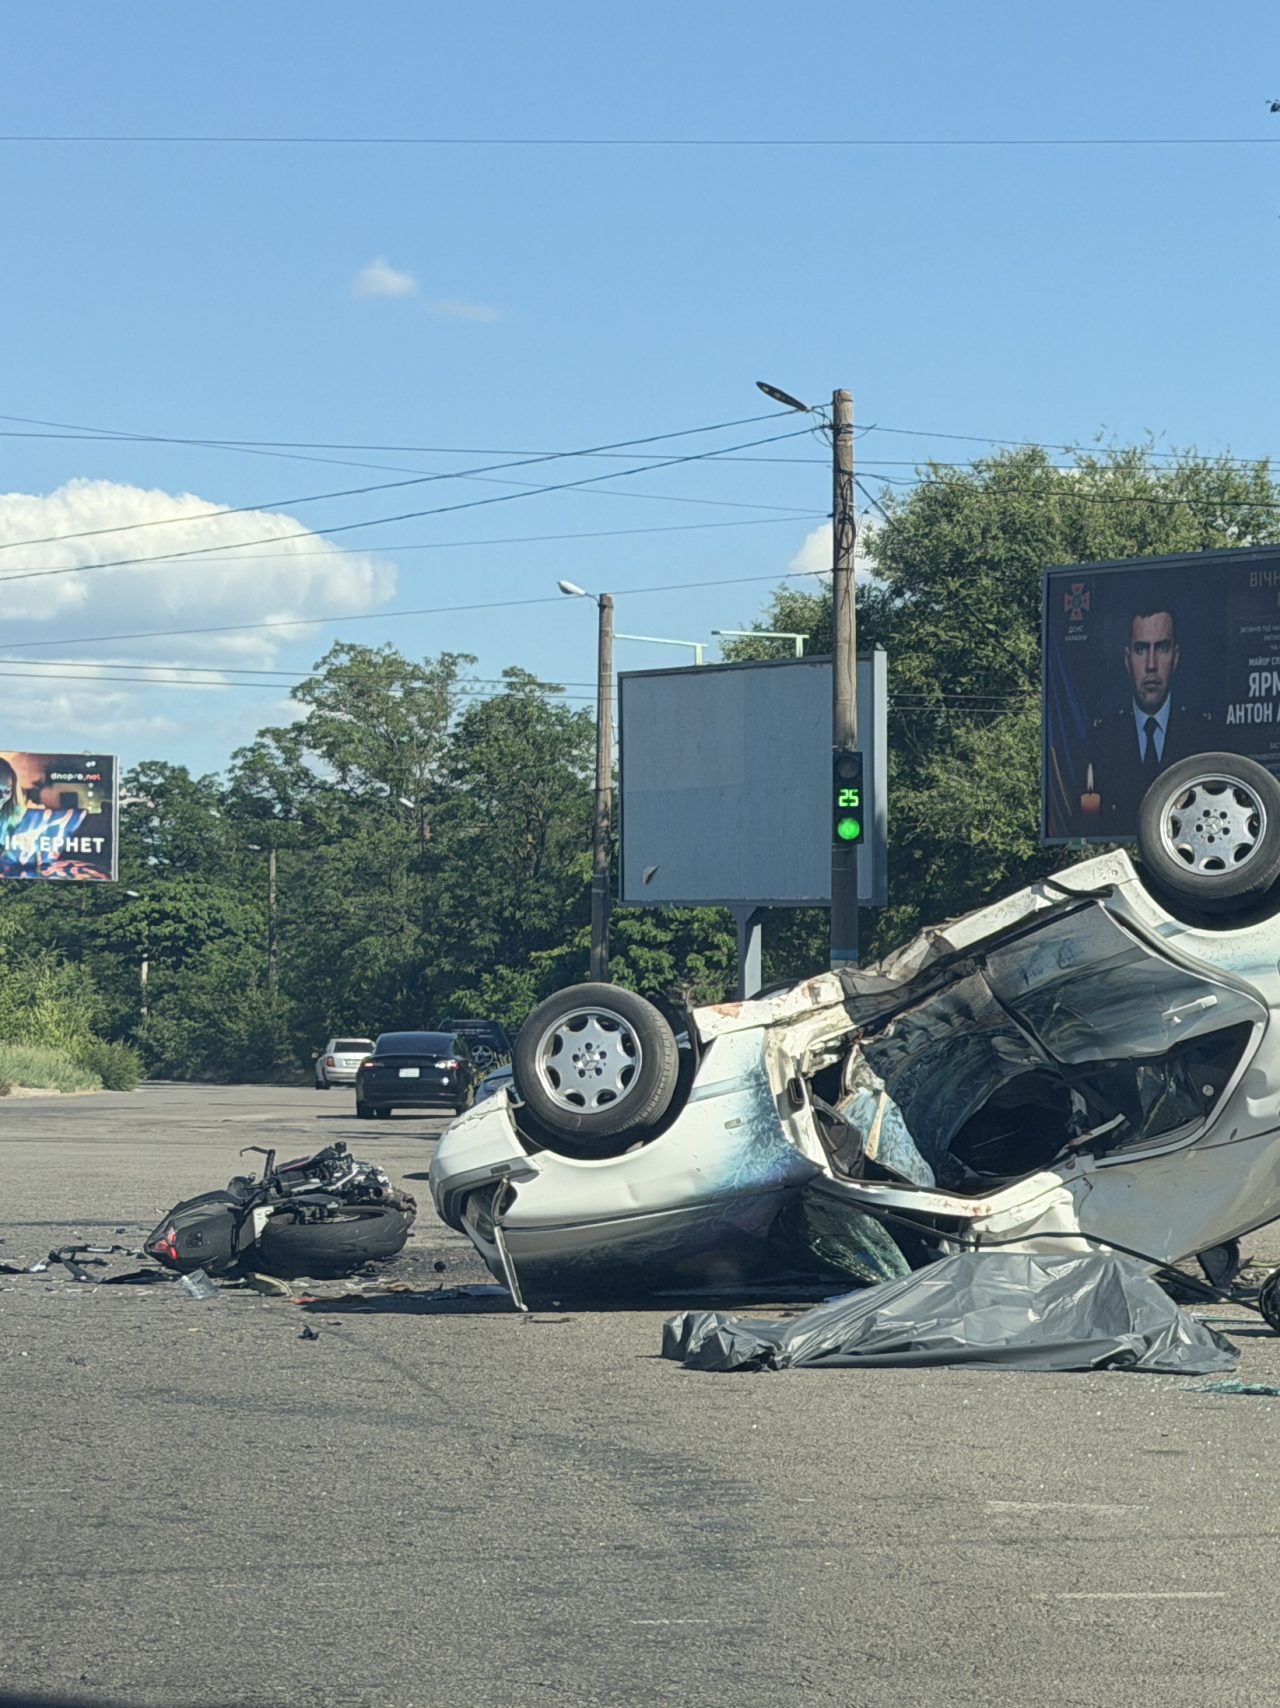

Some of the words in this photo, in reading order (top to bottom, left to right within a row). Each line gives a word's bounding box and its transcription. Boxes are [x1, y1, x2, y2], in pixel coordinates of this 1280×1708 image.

[1226, 701, 1273, 725] АНТОН
[838, 788, 859, 807] 25
[4, 835, 105, 854] ІНЕРНЕТ
